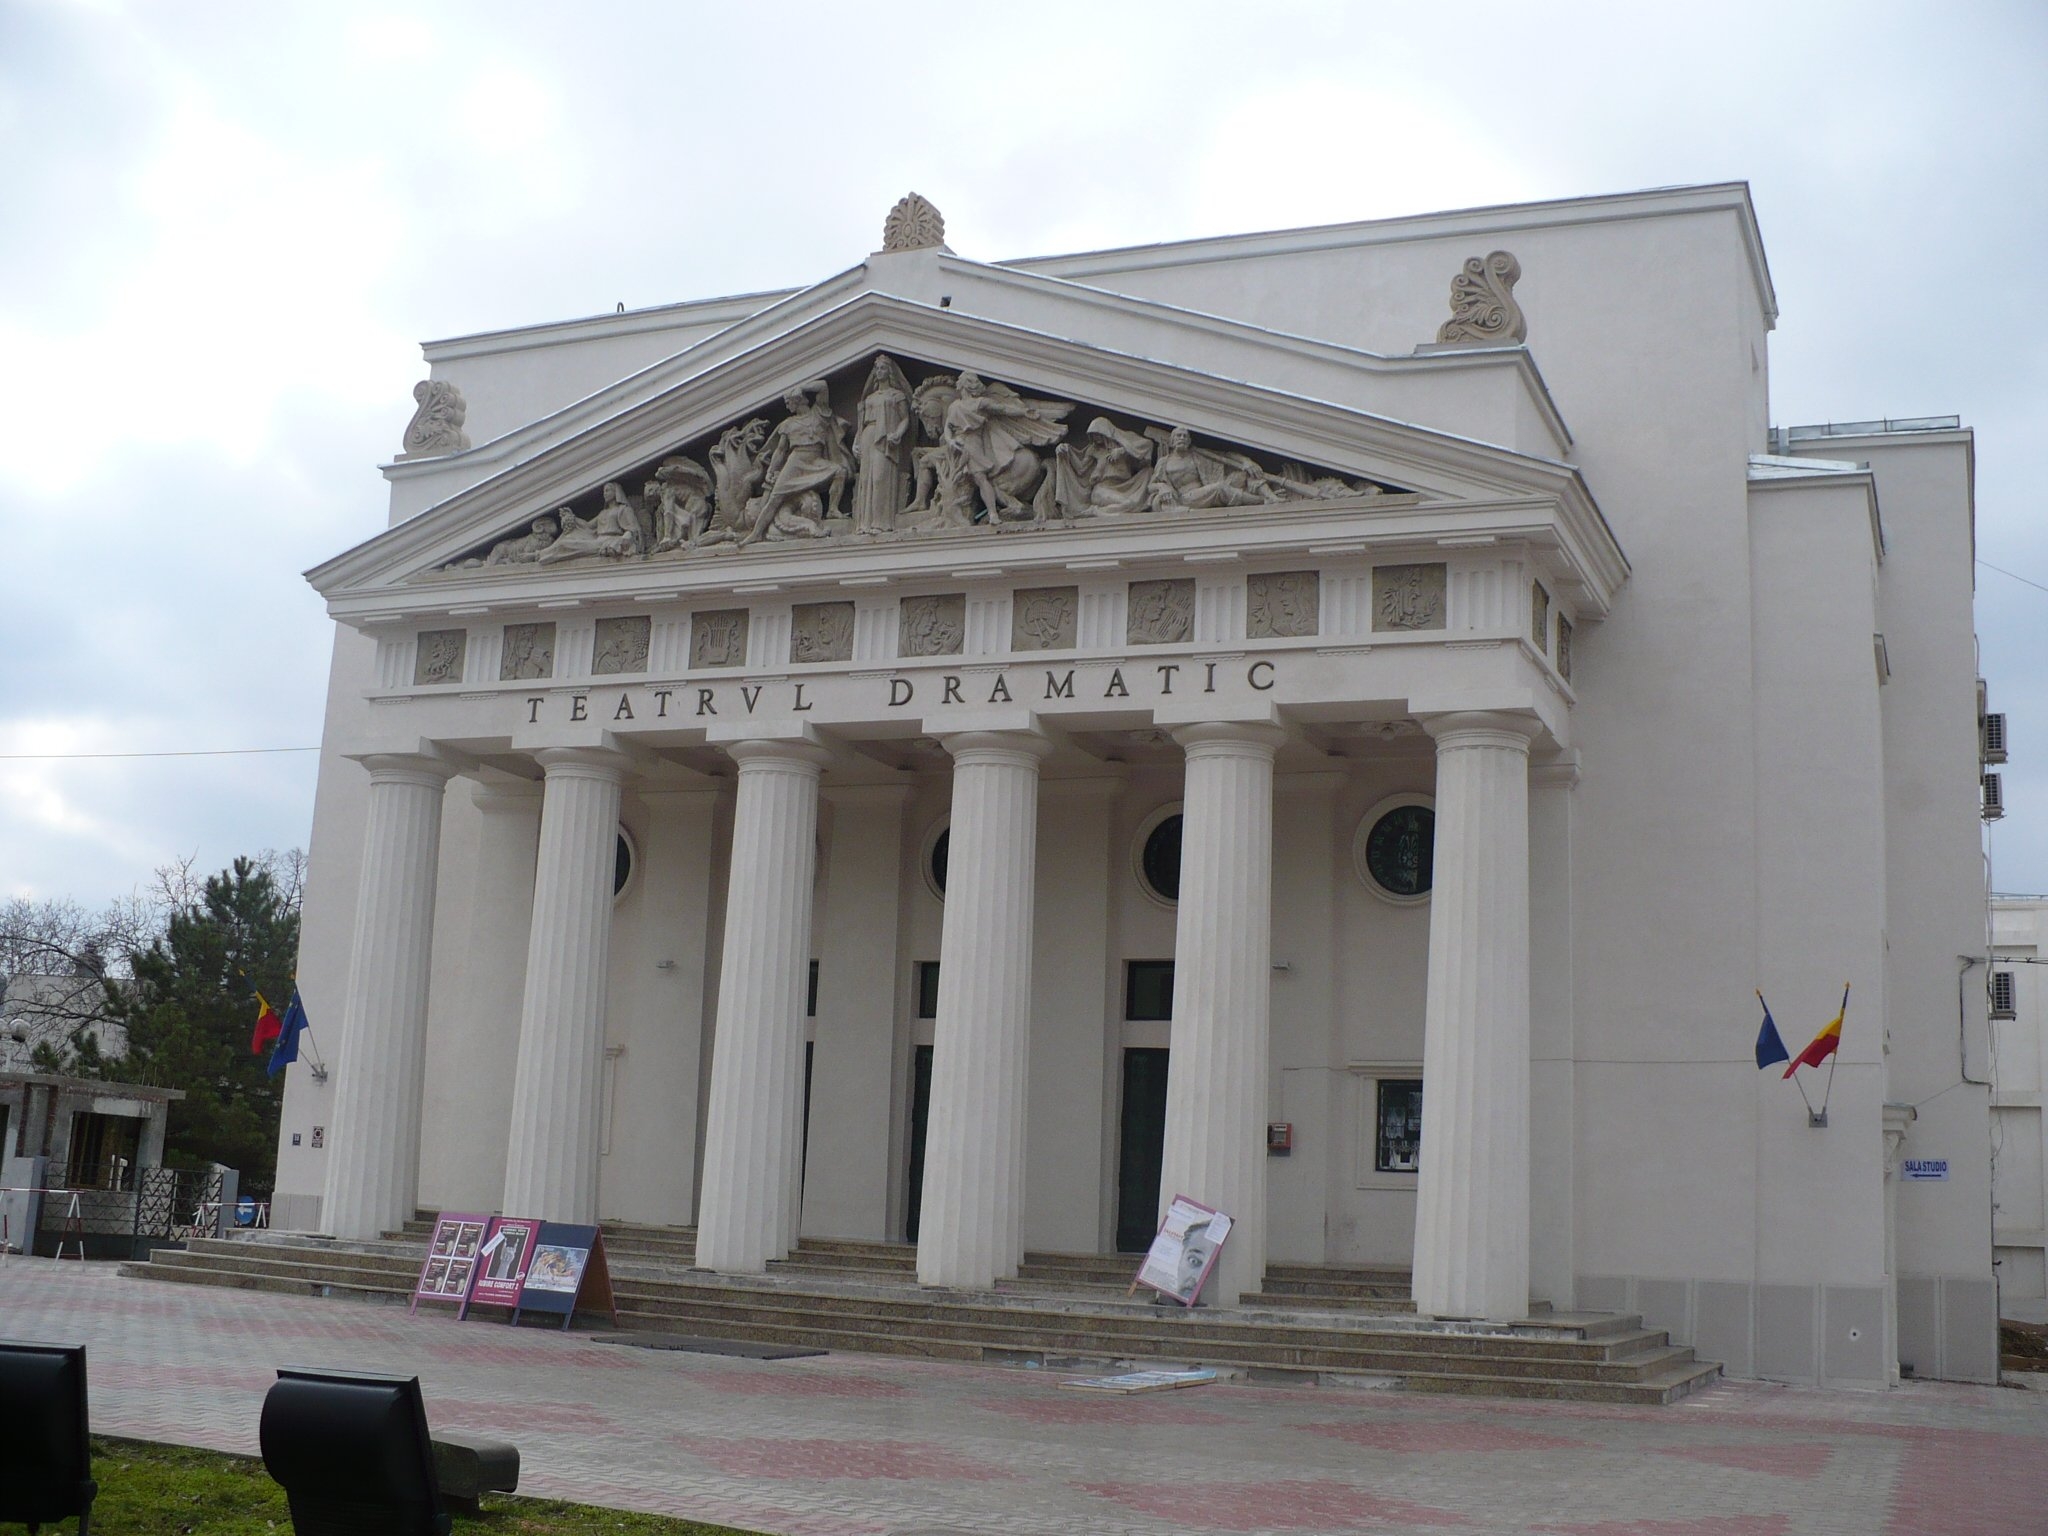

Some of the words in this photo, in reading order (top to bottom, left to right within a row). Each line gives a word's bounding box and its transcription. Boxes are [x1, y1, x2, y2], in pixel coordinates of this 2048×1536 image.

[527, 684, 813, 723] TEATRVL
[888, 661, 1275, 706] DRAMATIC
[1905, 1160, 1921, 1171] SALA
[1922, 1161, 1947, 1172] STUDIO
